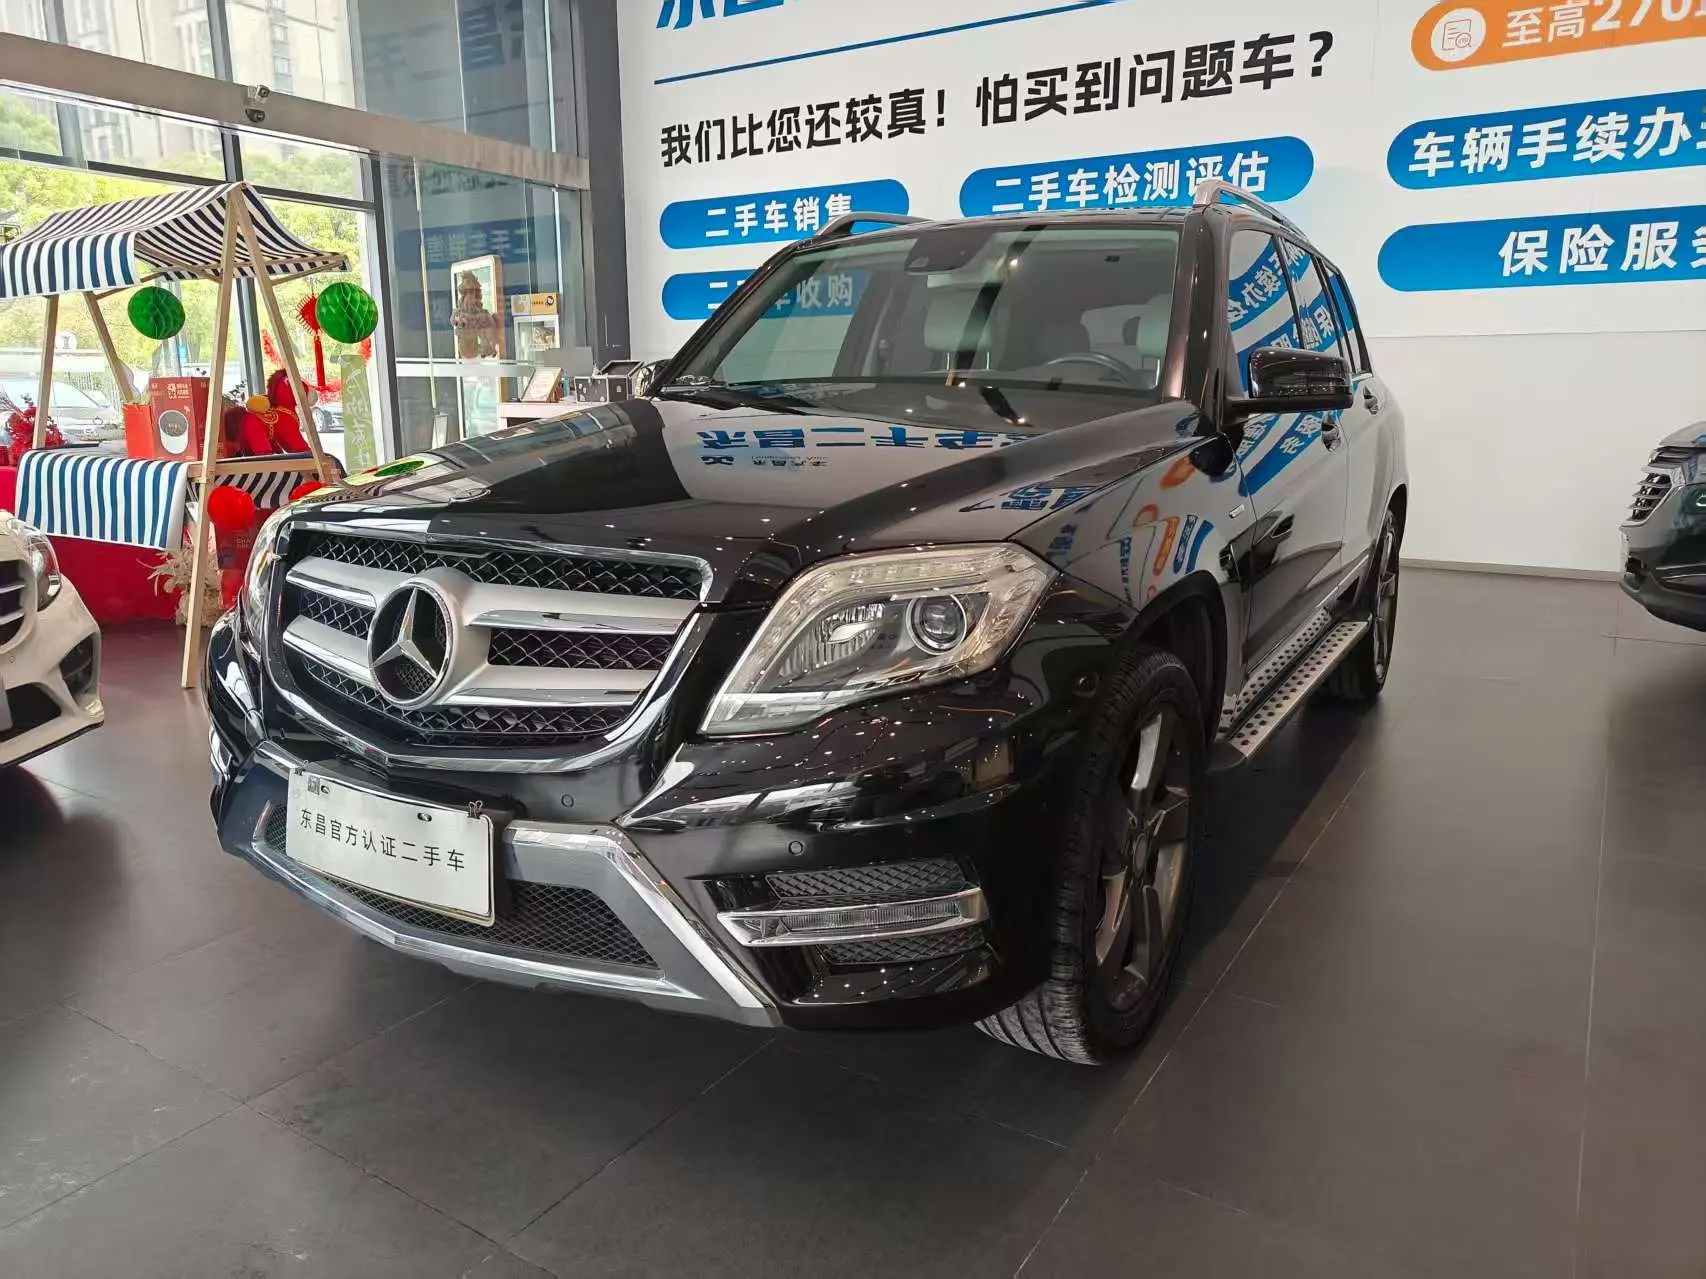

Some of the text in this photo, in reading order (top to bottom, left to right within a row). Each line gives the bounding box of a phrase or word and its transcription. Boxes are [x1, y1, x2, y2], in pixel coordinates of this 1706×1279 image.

[1408, 105, 1706, 178] 车辆手续办
[991, 149, 1269, 213] 二手车检测评估
[299, 807, 466, 872] 东昌官方认证二手车
